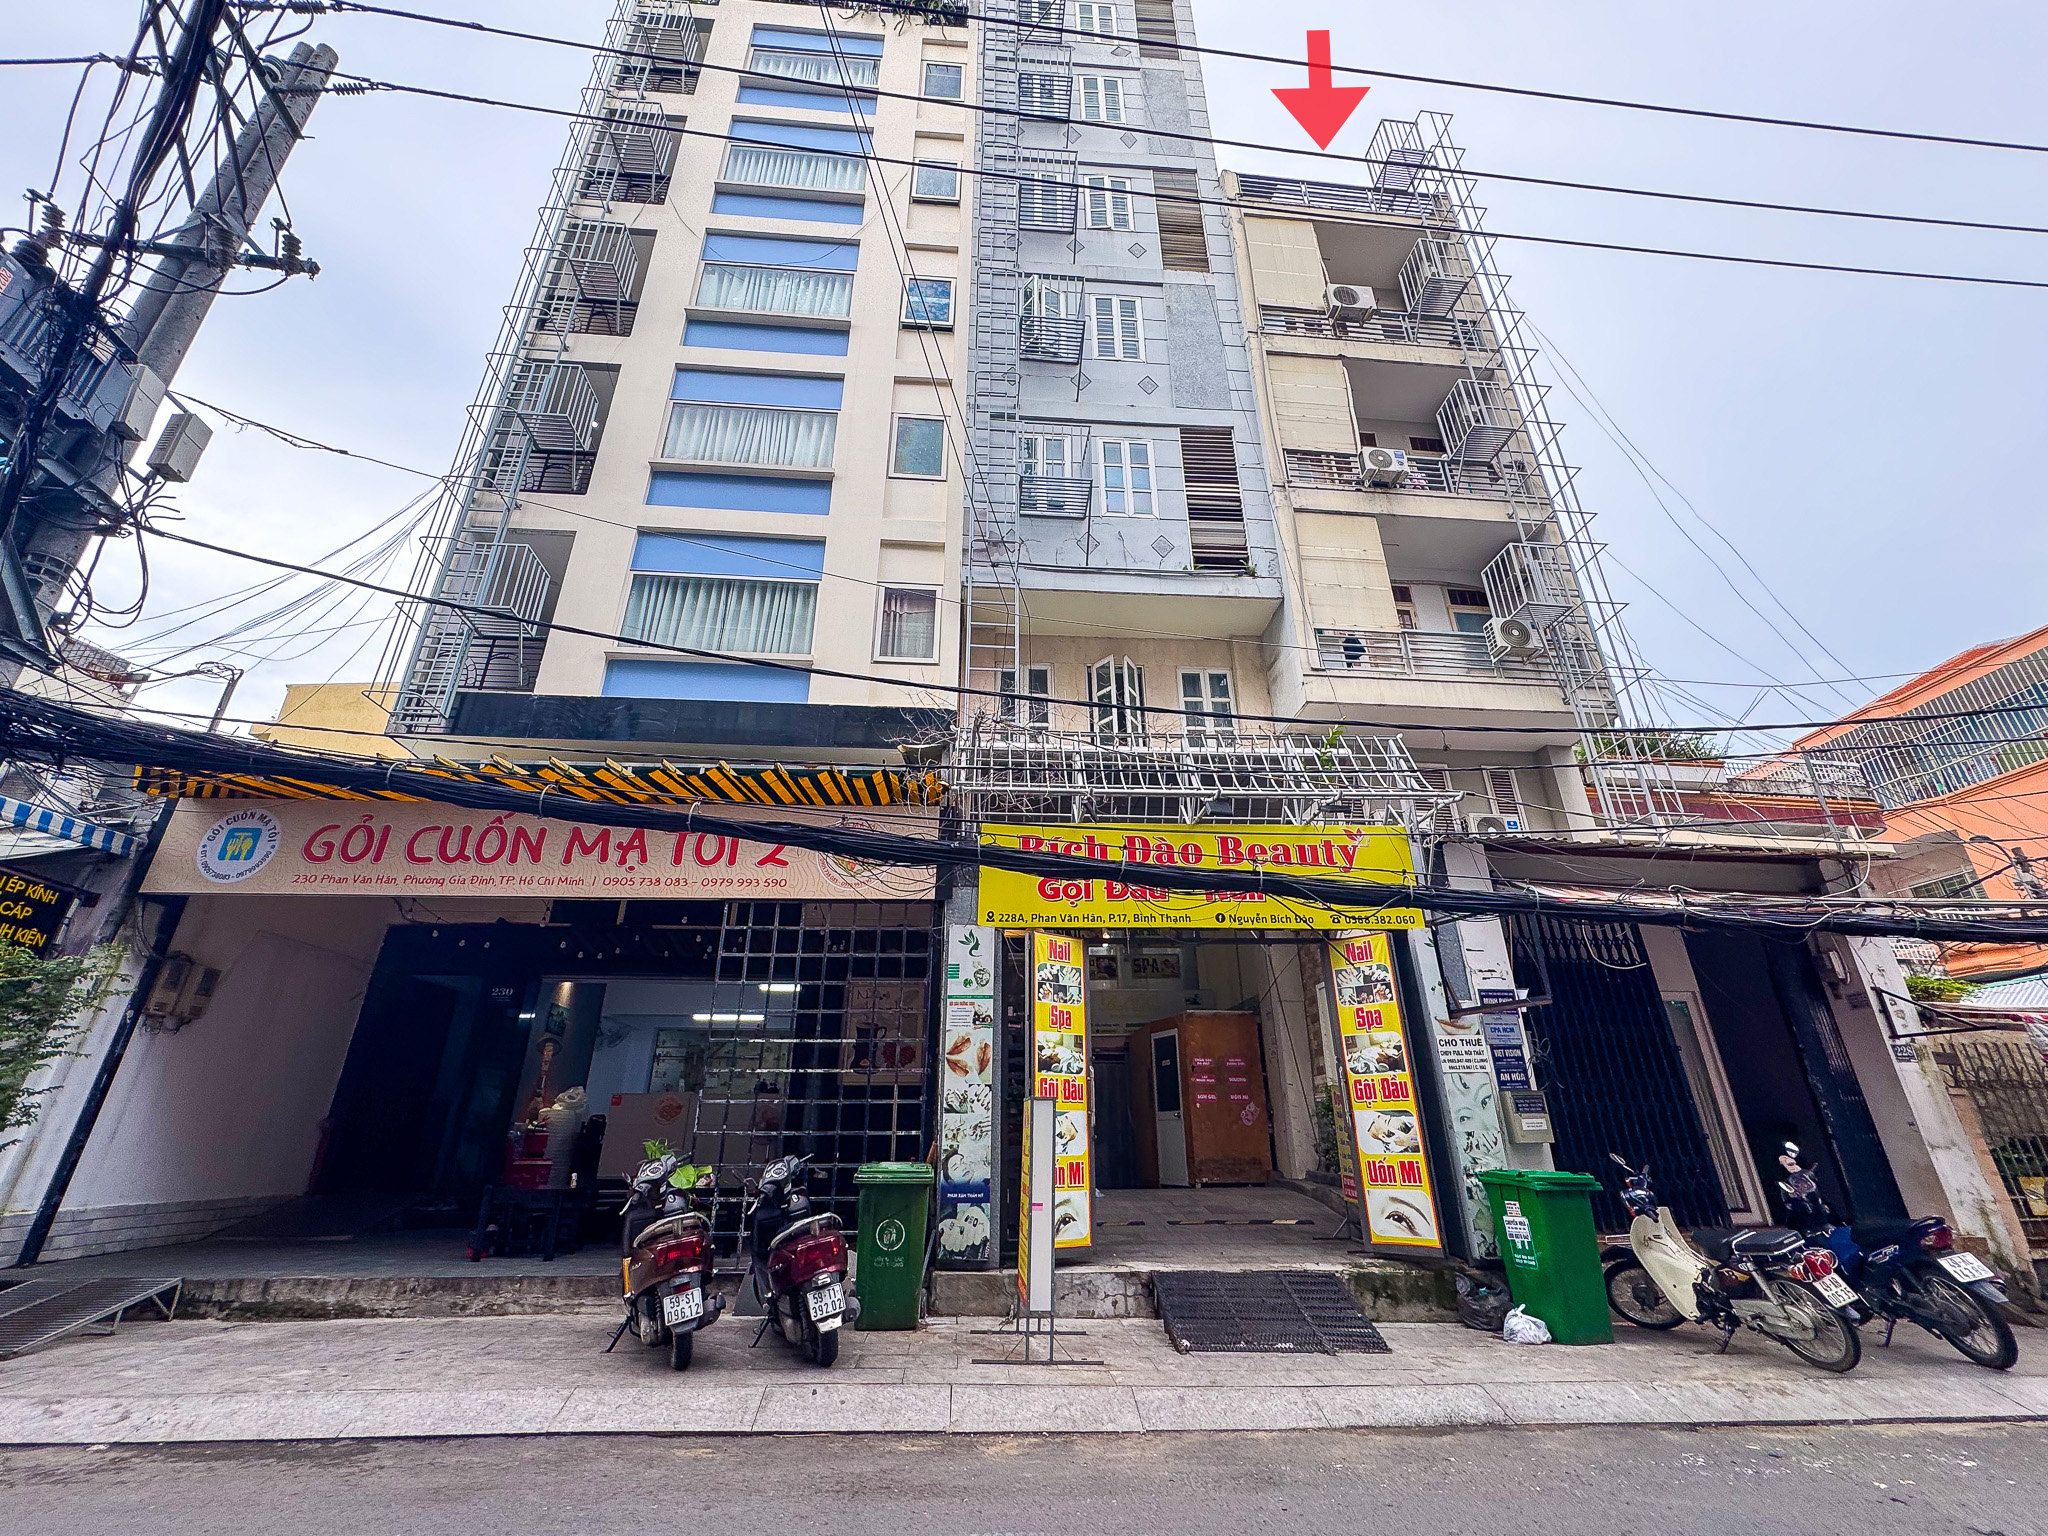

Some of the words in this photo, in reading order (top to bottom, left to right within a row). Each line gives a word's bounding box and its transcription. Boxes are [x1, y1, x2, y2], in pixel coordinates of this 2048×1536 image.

[302, 814, 392, 864] GỎI
[405, 812, 548, 864] CUỐN
[562, 827, 648, 872] MẠ
[1124, 834, 1204, 866] Đào
[1216, 834, 1359, 873] Beauty
[5, 876, 26, 893] ÉP
[25, 884, 59, 905] KÍNH
[291, 874, 318, 885] 230
[320, 873, 349, 885] Phan
[353, 874, 373, 885] Văn
[403, 875, 445, 887] Phường
[449, 875, 466, 885] Gia
[469, 875, 498, 887] Định,
[537, 876, 555, 886] Chí
[557, 876, 584, 886] Minh
[602, 877, 635, 887] 0905
[639, 877, 661, 887] 738
[664, 877, 688, 887] 083
[701, 877, 733, 888] 0979
[737, 877, 760, 888] 993
[763, 877, 787, 888] 590
[0, 901, 33, 920] CÁP
[998, 914, 1028, 924] 228A,
[1031, 914, 1057, 923] Phan
[1060, 913, 1080, 923] Văn
[1133, 913, 1157, 923] Bình
[1159, 913, 1192, 925] Thạnh
[1228, 912, 1268, 925] Nguyễn
[1270, 913, 1292, 924] Bích
[14, 927, 47, 947] KIỆN
[1048, 939, 1071, 962] Nail
[1344, 941, 1374, 965] Nail
[1133, 958, 1160, 973] SPA
[491, 987, 514, 996] 230
[1049, 1005, 1072, 1031] Spa
[1355, 1006, 1383, 1031] Spa
[1438, 1038, 1458, 1047] CHO
[1895, 1046, 1914, 1057] 228
[1062, 1075, 1084, 1102] Đầu
[1353, 1078, 1378, 1108] Gội
[1379, 1074, 1410, 1101] Đầu
[1068, 1160, 1085, 1188] Mi
[1365, 1157, 1398, 1186] Uốn
[1398, 1160, 1423, 1187] Mi
[669, 1291, 695, 1309] 59-S1
[811, 1298, 843, 1318] 392.02
[667, 1302, 700, 1325] 096.12
